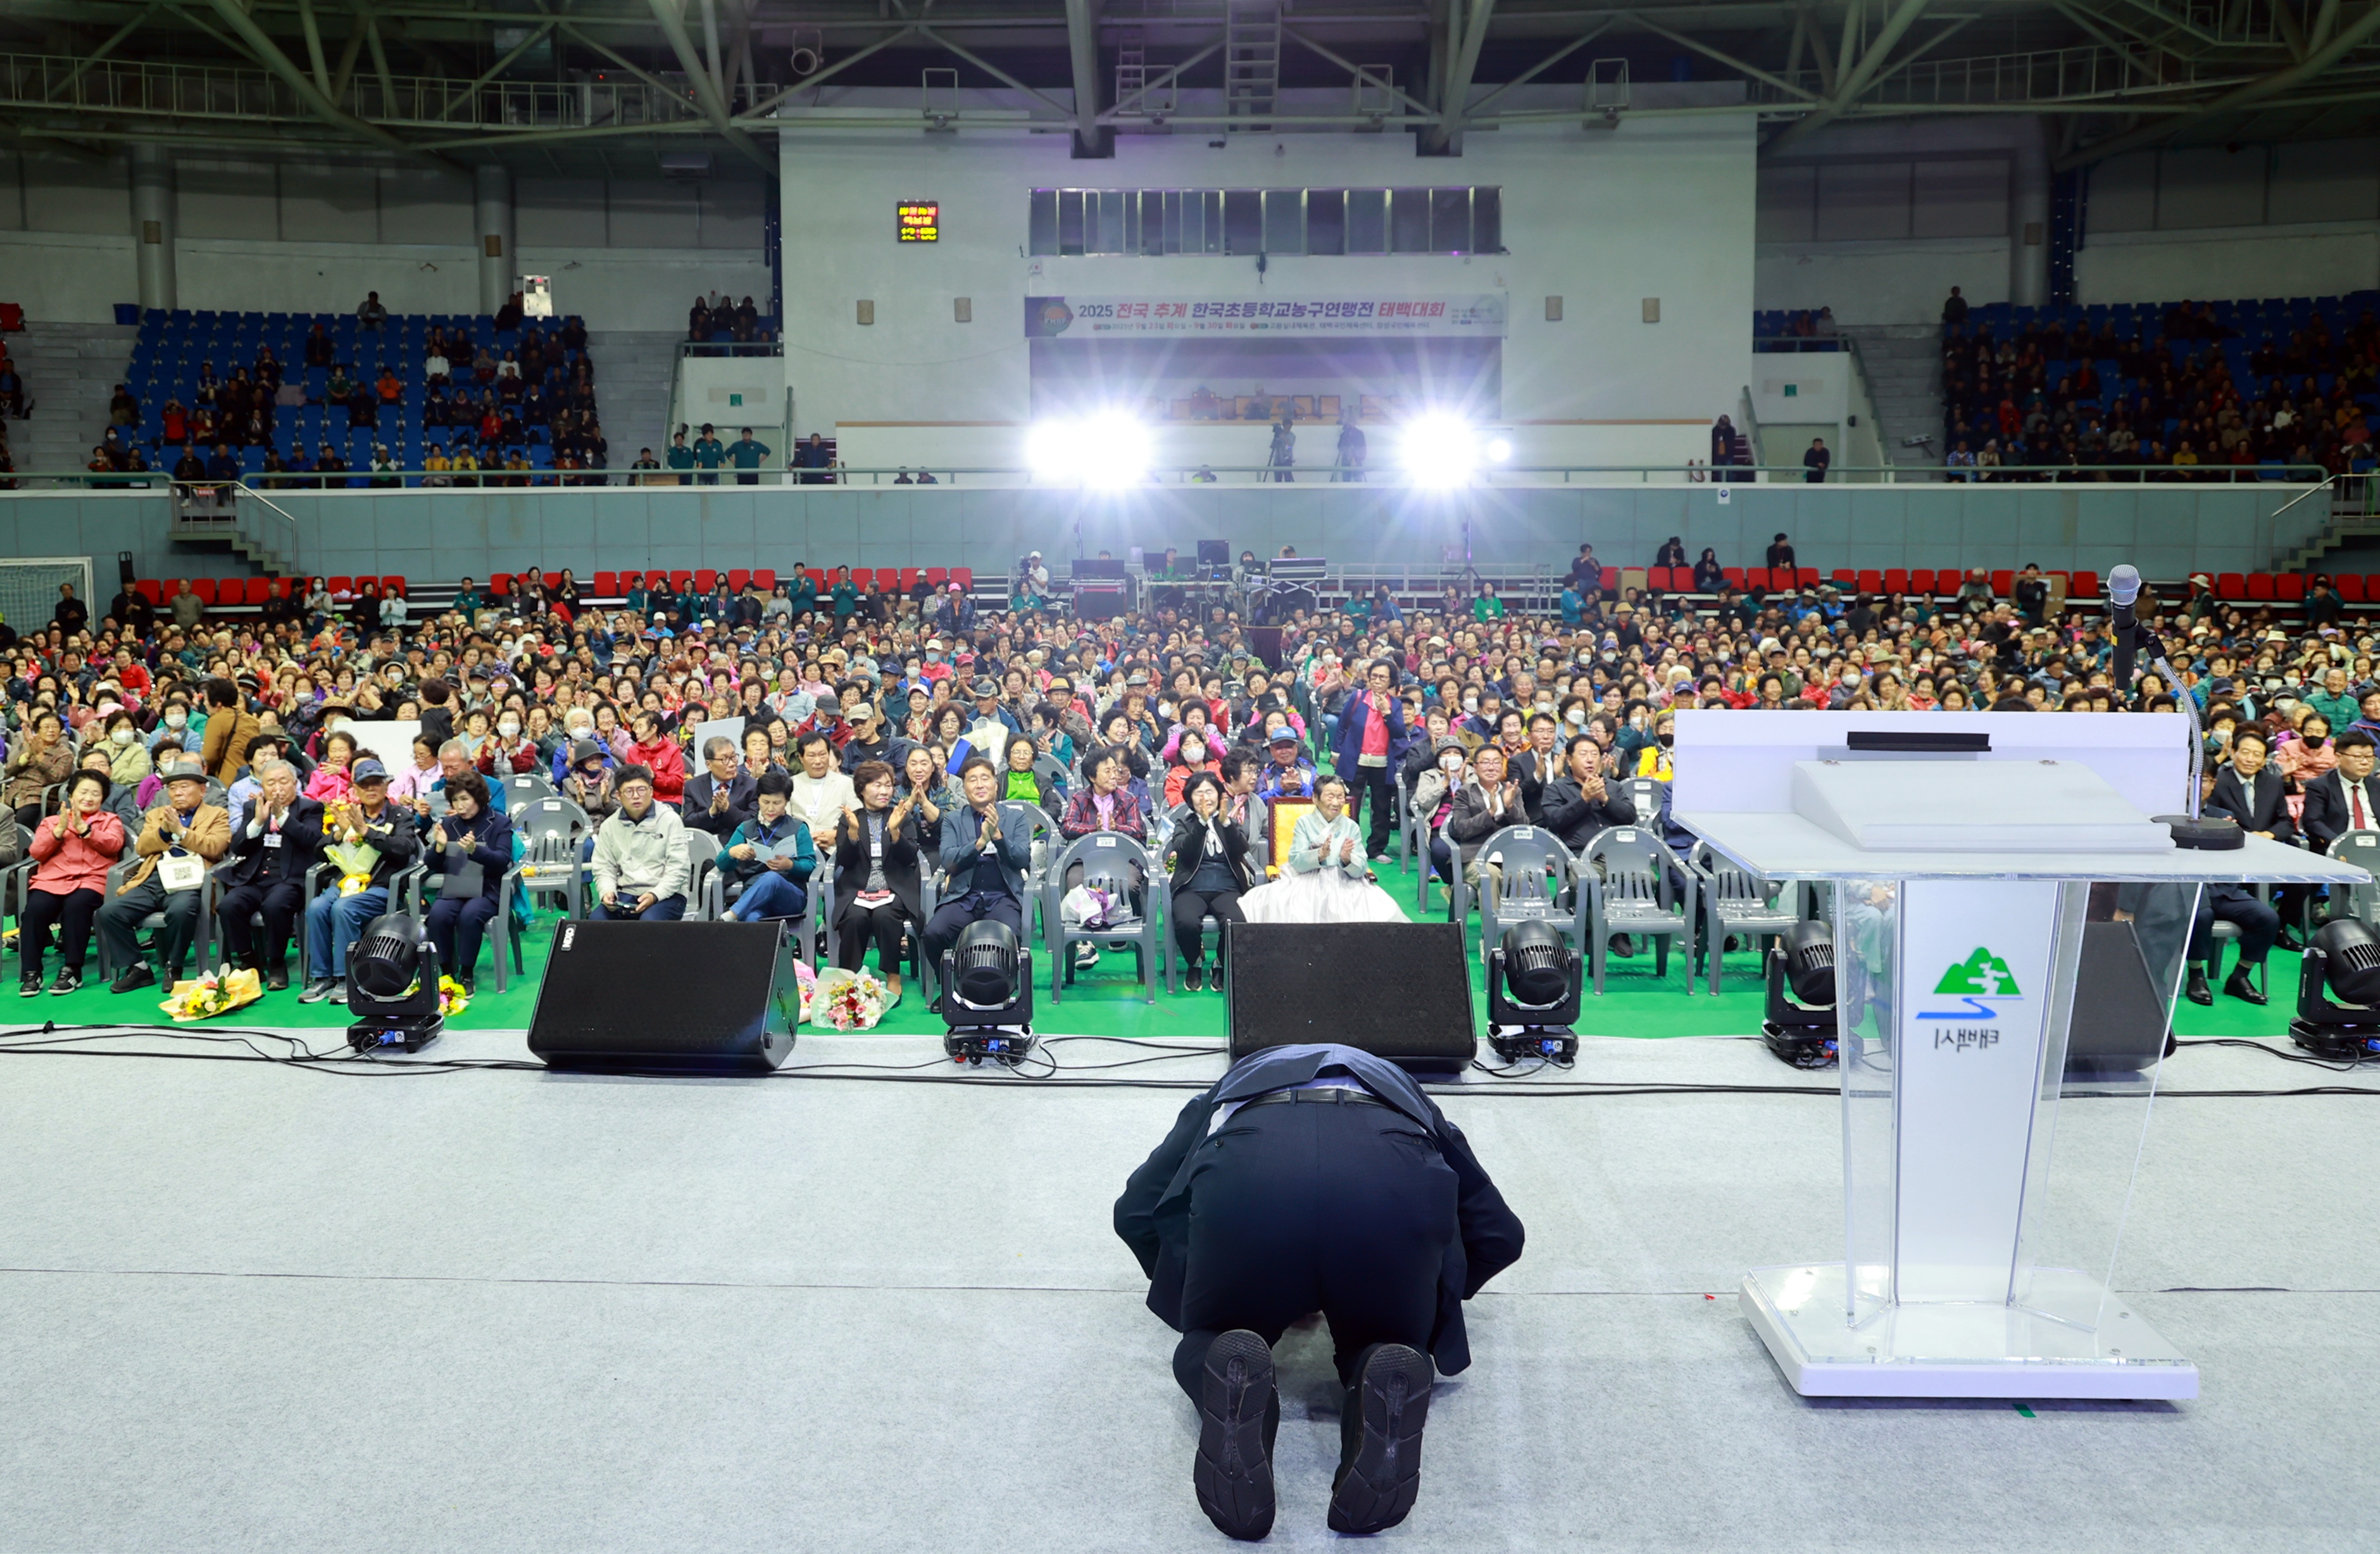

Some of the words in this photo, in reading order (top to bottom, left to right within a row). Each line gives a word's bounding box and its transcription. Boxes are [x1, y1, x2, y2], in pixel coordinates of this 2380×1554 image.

[1079, 304, 1113, 318] 2025
[1117, 303, 1149, 318] 전국
[1154, 303, 1188, 318] 추계
[1192, 302, 1374, 318] 한국초등학교농구연맹전
[1378, 301, 1446, 318] 태백대회
[561, 927, 575, 948] NEXO
